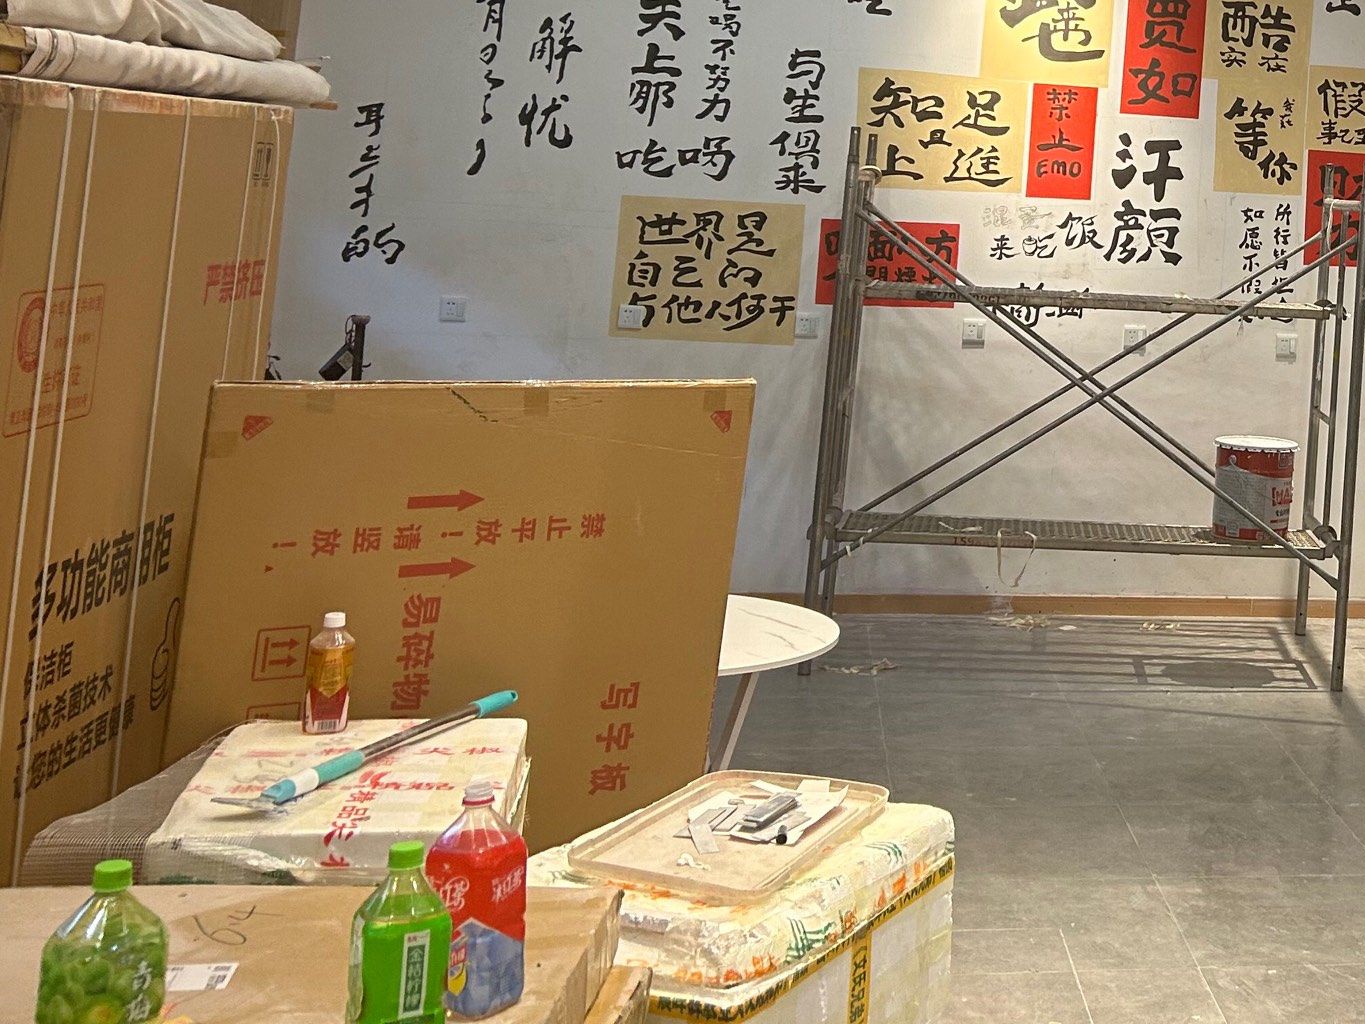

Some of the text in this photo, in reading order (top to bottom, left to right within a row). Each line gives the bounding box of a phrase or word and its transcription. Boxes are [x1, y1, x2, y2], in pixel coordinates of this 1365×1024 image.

[769, 48, 826, 194] 与生俱来
[29, 512, 174, 642] 多功能商用柜
[588, 680, 642, 796] 写字板
